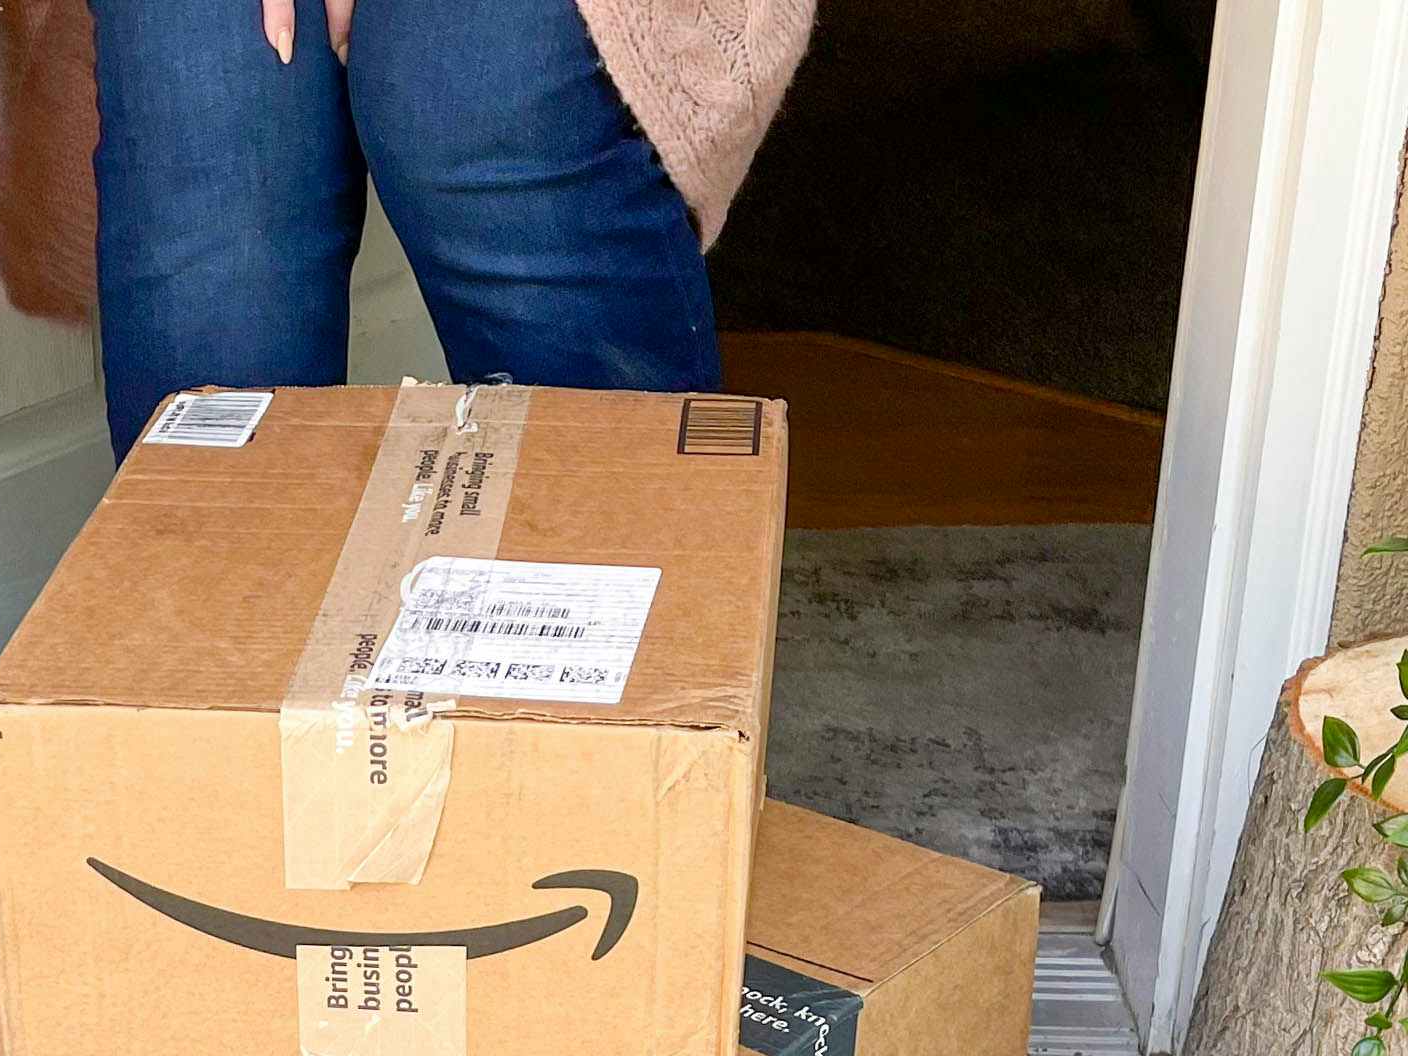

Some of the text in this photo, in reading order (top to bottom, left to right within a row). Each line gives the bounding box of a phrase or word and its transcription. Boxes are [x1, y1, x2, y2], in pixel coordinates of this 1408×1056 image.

[433, 499, 452, 511] to
[460, 452, 494, 516] Bringing small
[424, 511, 445, 536] more
[369, 711, 388, 784] more
[325, 945, 353, 1009] Bring
[357, 946, 381, 1011] busin
[389, 945, 419, 1013] peopl
[739, 1003, 790, 1033] here.
